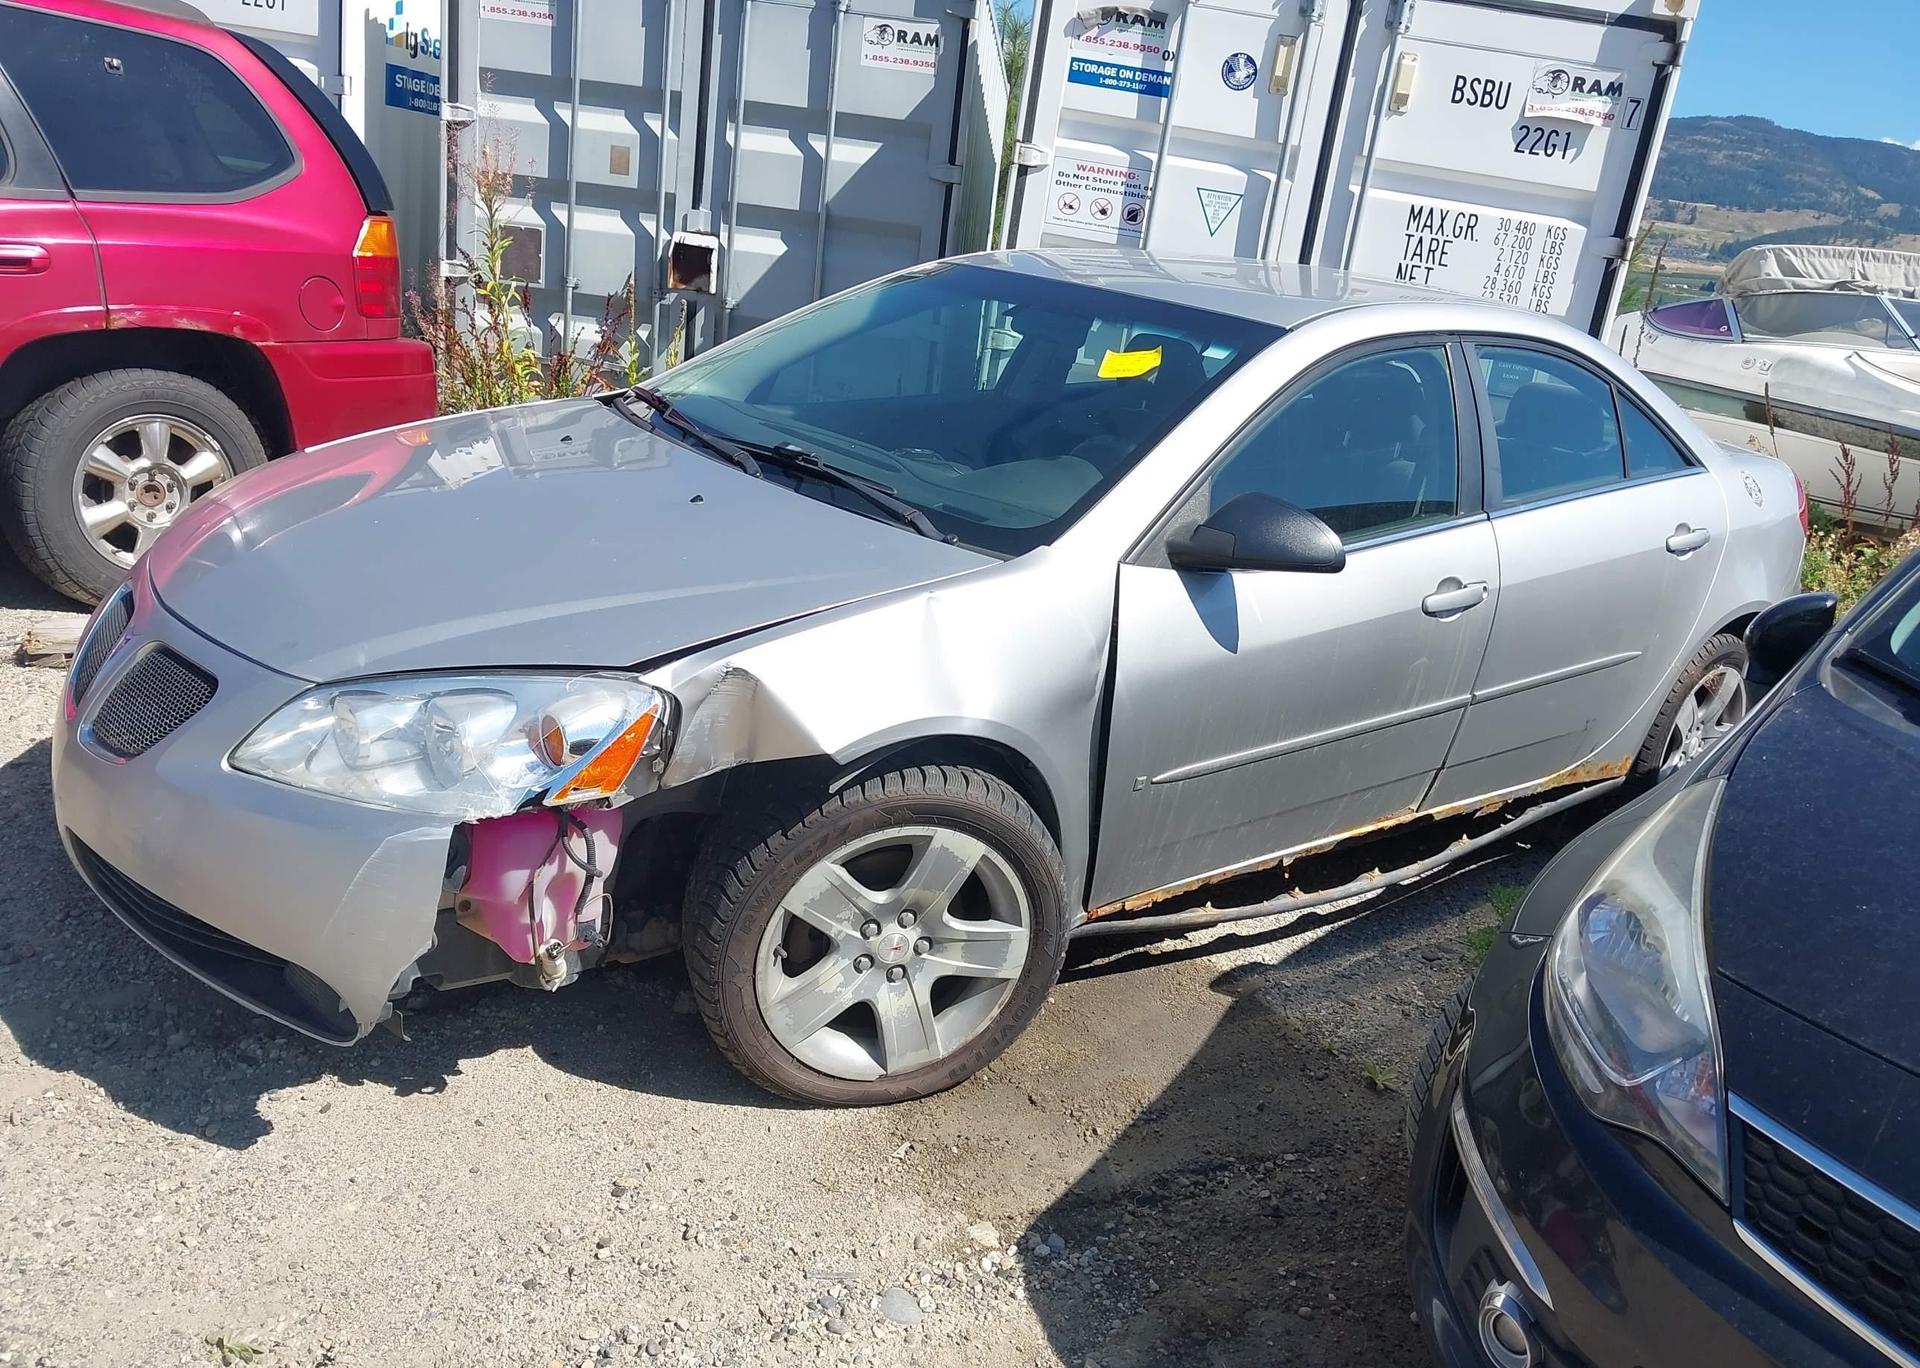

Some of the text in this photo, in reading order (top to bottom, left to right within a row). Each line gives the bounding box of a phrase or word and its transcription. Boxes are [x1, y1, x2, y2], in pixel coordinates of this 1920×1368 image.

[482, 5, 554, 20] 1.855.238.9350
[896, 29, 939, 48] RAM
[1071, 61, 1172, 86] STORAGE ON DEMAN
[1451, 74, 1512, 110] BSBU
[1571, 76, 1624, 97] RAM
[1626, 99, 1642, 128] 7
[1513, 125, 1572, 160] 22G1
[1057, 171, 1071, 179] Do
[1072, 173, 1089, 182] Not
[1092, 176, 1118, 186] Store
[1121, 181, 1143, 190] Fuel
[1076, 164, 1140, 180] WARNING:
[1055, 180, 1083, 189] Other
[1497, 217, 1536, 236] 30.480
[1546, 225, 1568, 241] KGS
[1403, 233, 1560, 270] TARE 2.120 KGS
[1494, 232, 1564, 256] 67.200 LBS
[1395, 263, 1553, 299] NET 28.360 KGS
[1494, 262, 1556, 285] 4.670 LBS
